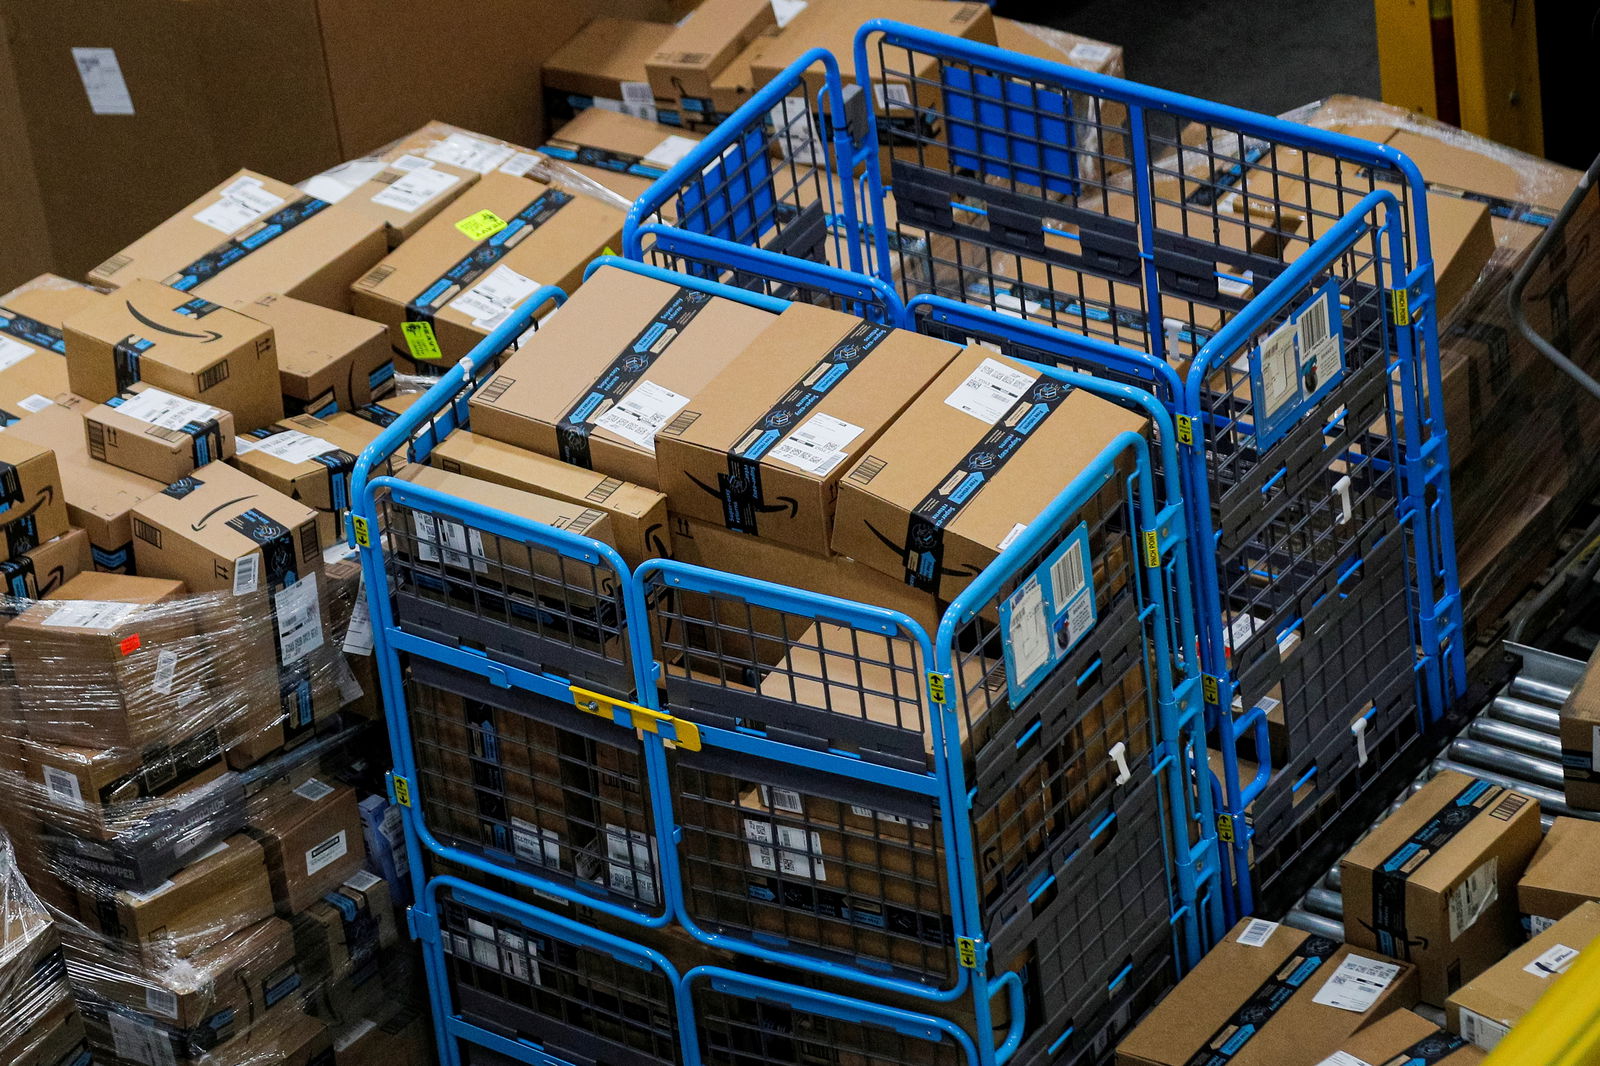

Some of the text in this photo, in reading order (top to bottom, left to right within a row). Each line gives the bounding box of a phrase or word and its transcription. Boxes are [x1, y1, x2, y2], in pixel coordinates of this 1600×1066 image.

[660, 297, 684, 320] Super-easy
[668, 306, 683, 321] returns
[421, 322, 438, 353] HEAVY
[862, 329, 887, 350] Super-easy
[863, 327, 880, 342] returns
[597, 366, 621, 389] Super-easy
[604, 375, 620, 391] returns
[794, 394, 819, 416] Super-easy
[795, 392, 812, 407] returns
[997, 436, 1022, 460] Super-easy
[998, 433, 1015, 448] returns
[931, 503, 949, 519] returns
[1147, 532, 1158, 567] PINCH POINT
